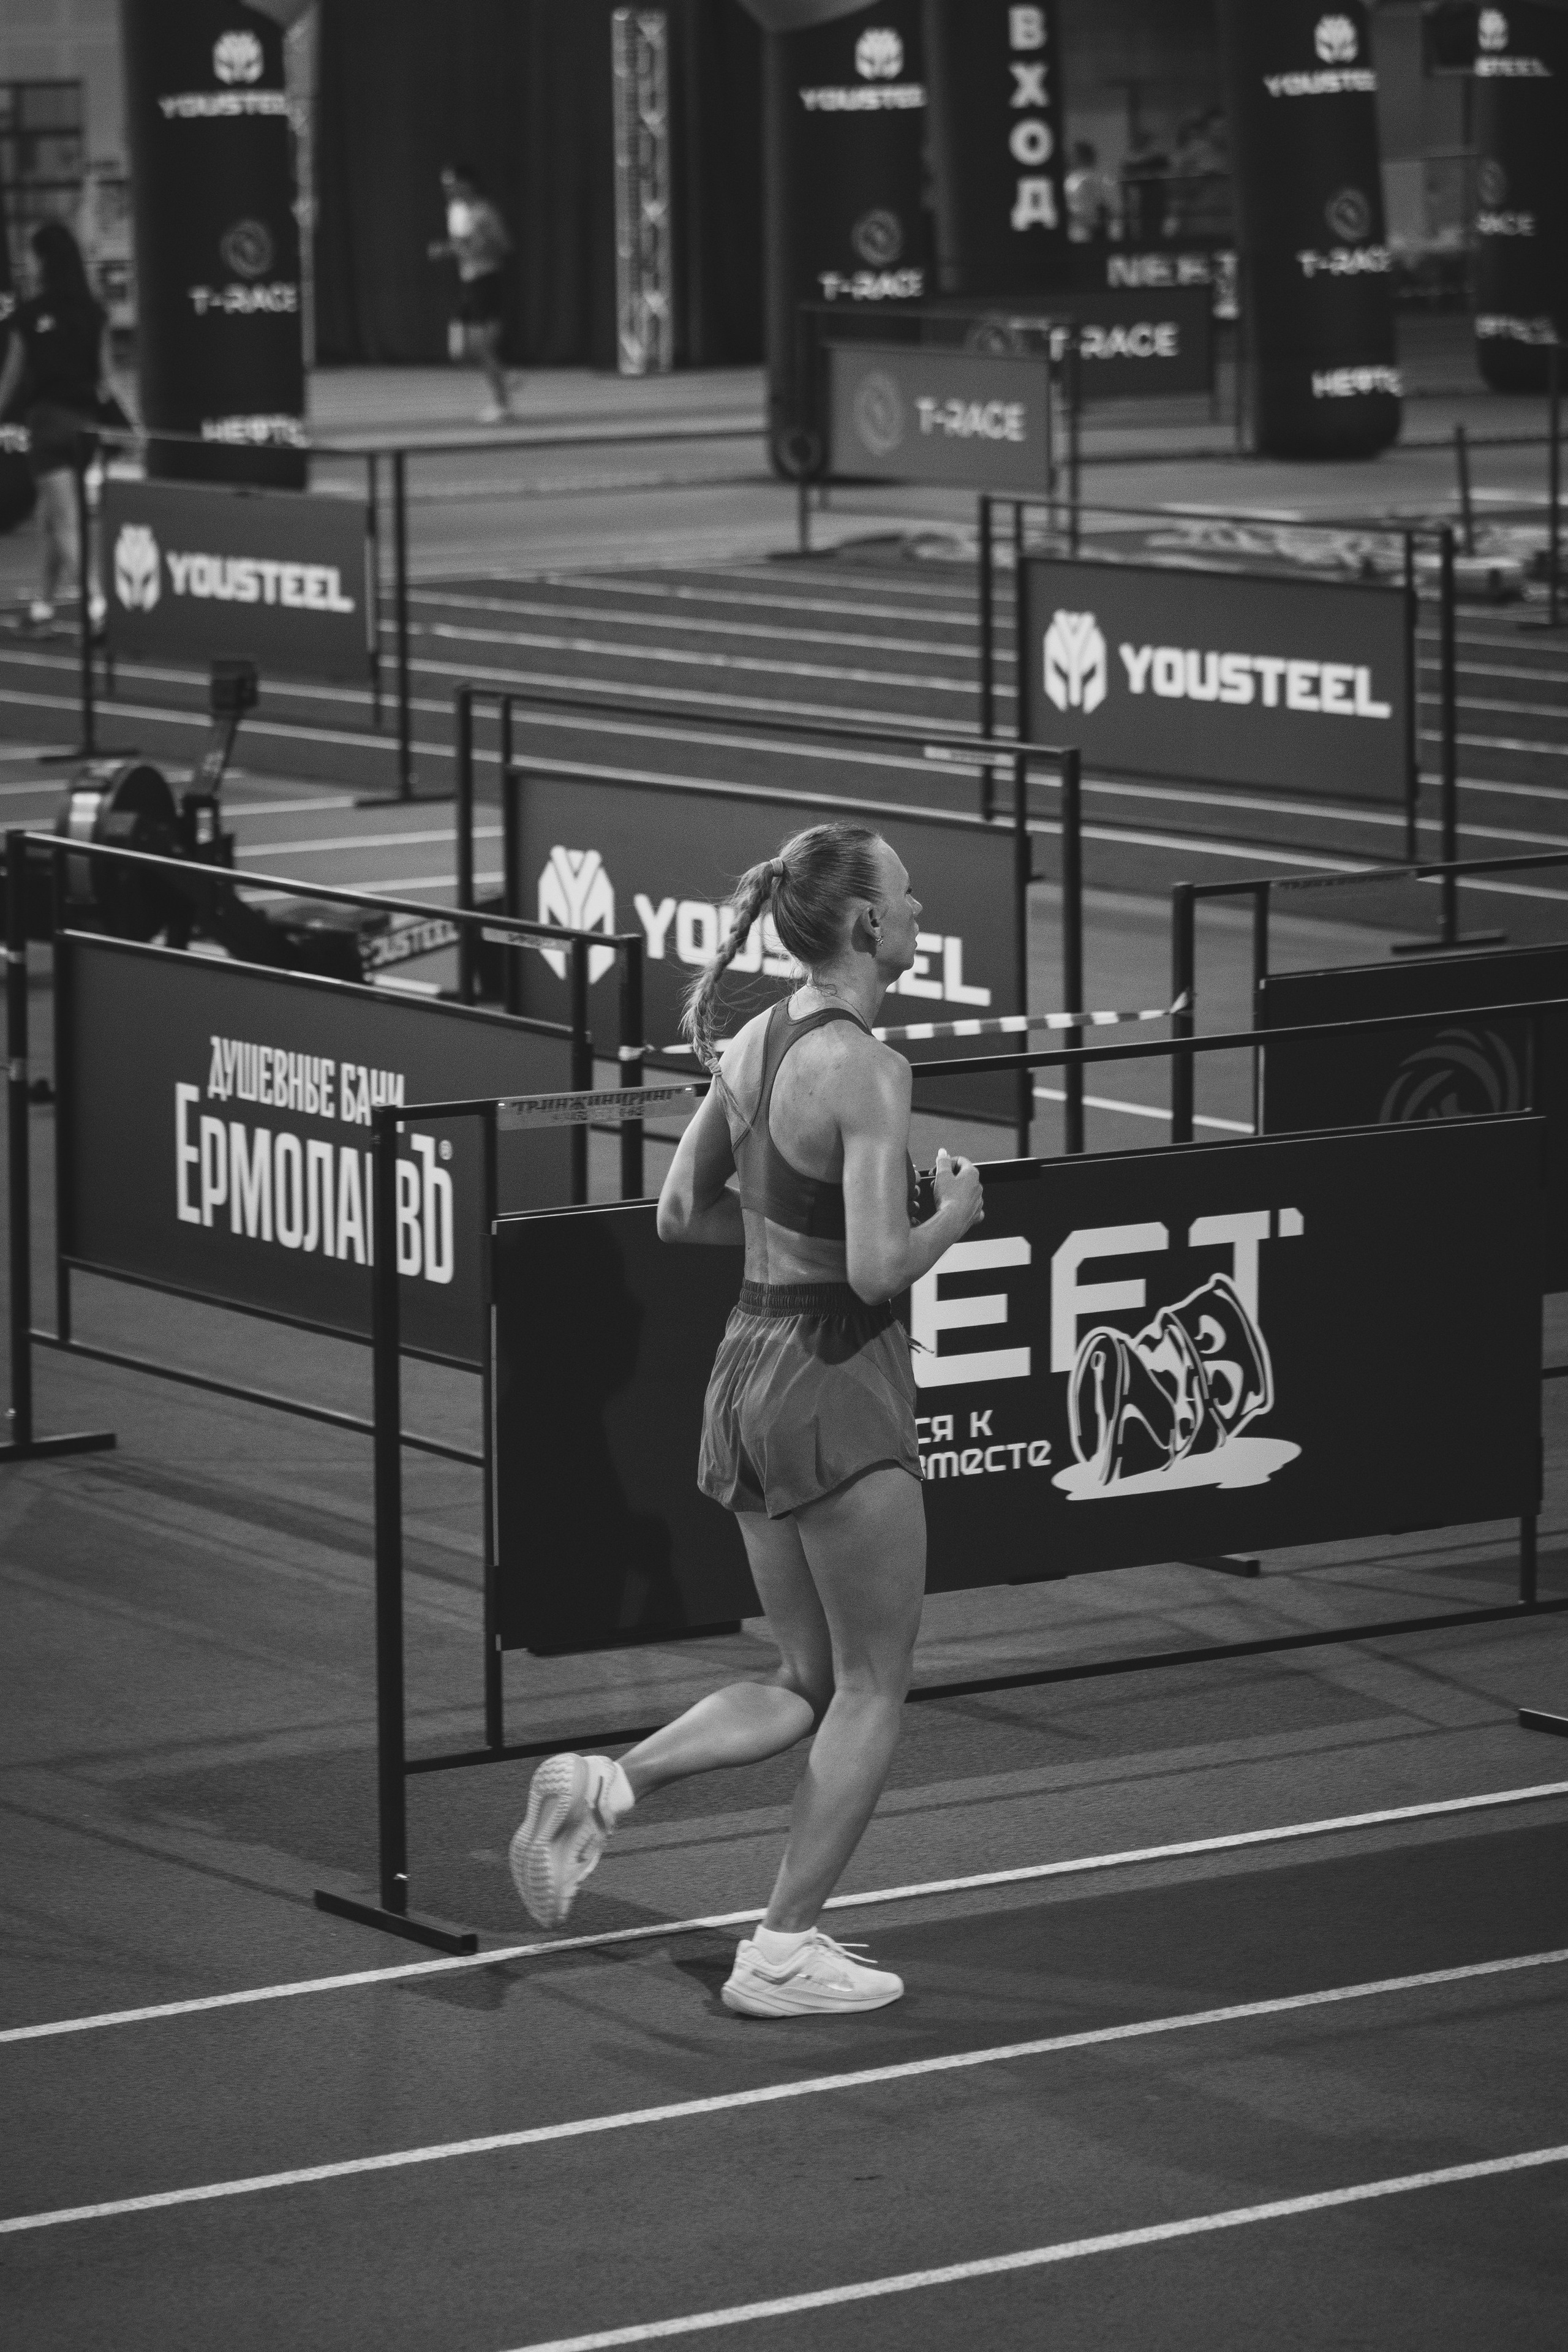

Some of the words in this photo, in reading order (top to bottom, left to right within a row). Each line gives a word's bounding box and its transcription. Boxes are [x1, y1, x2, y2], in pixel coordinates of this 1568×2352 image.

[165, 552, 355, 612] YOUSTEEL
[1118, 642, 1392, 719] YOUSTEEL
[634, 894, 991, 1006] YOUSEL
[208, 1035, 336, 1119] ДУШЕВНЫЕ
[176, 1082, 454, 1284] ЕРМОЛАВЪ
[910, 1207, 1305, 1389] EFT
